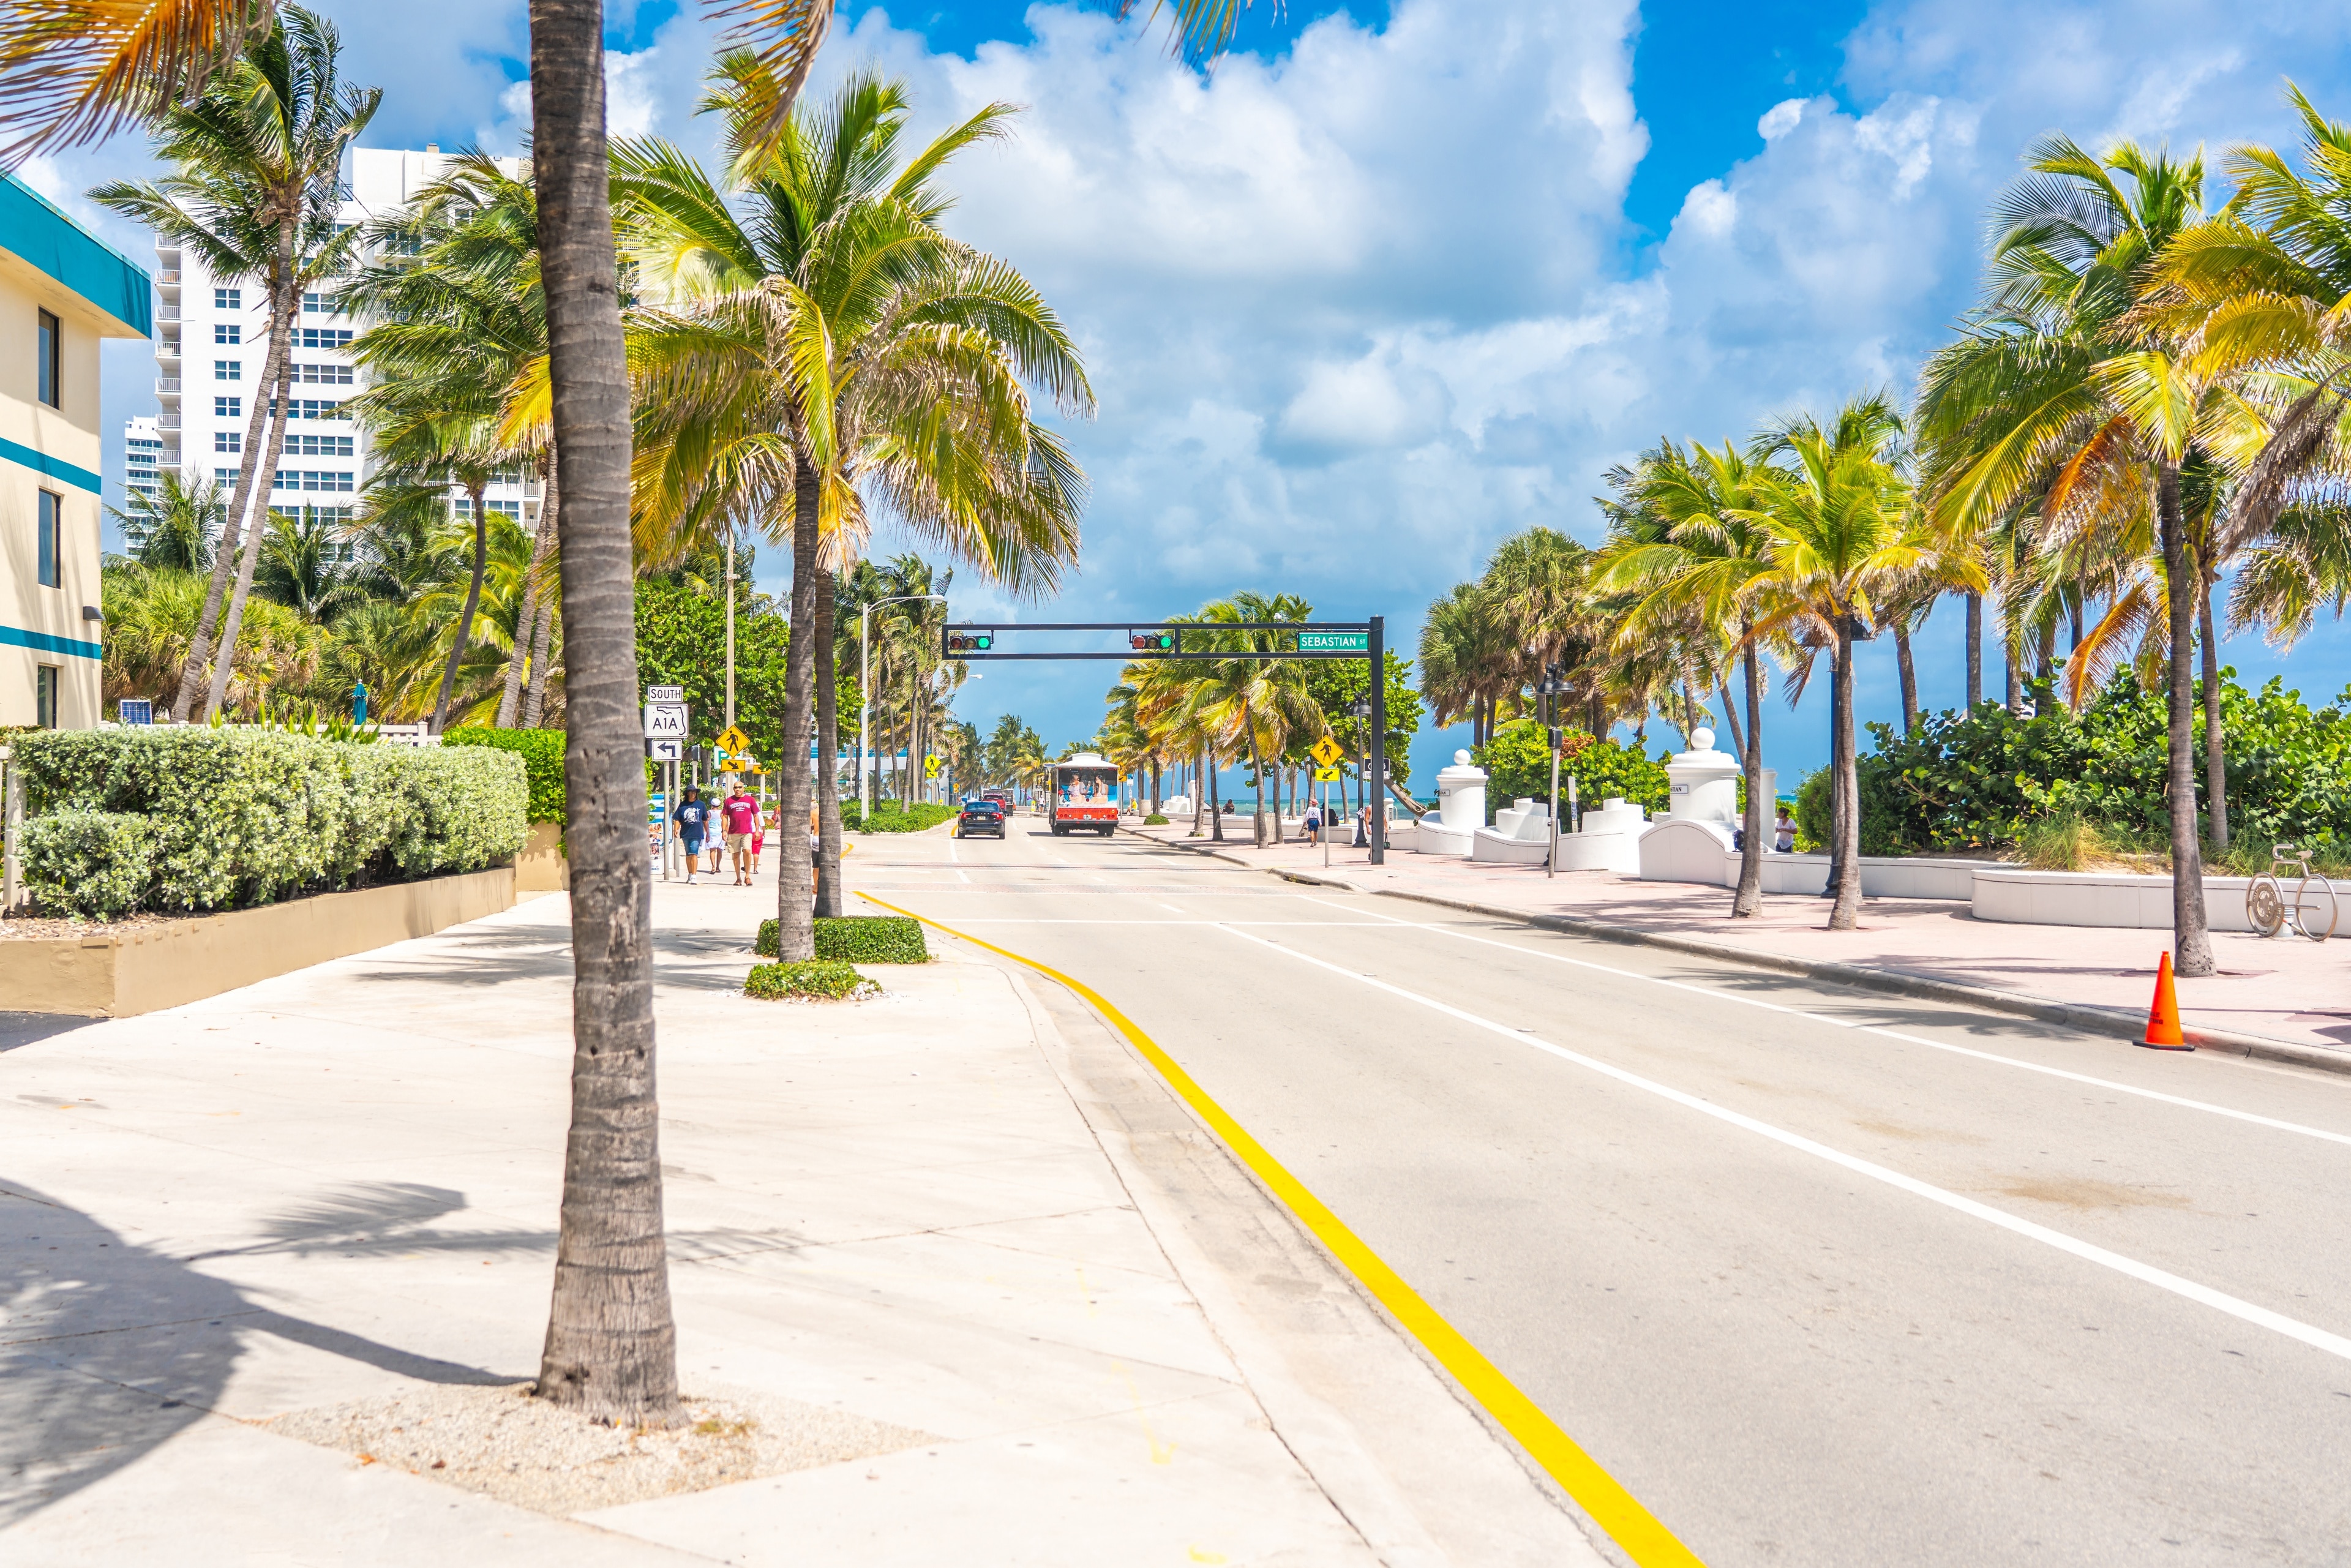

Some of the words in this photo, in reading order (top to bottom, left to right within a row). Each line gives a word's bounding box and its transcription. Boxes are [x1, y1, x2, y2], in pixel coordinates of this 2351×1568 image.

[1302, 637, 1356, 647] SEBASTIAN
[651, 689, 681, 699] SOUTH
[653, 718, 678, 729] A1A
[718, 751, 730, 765] P
